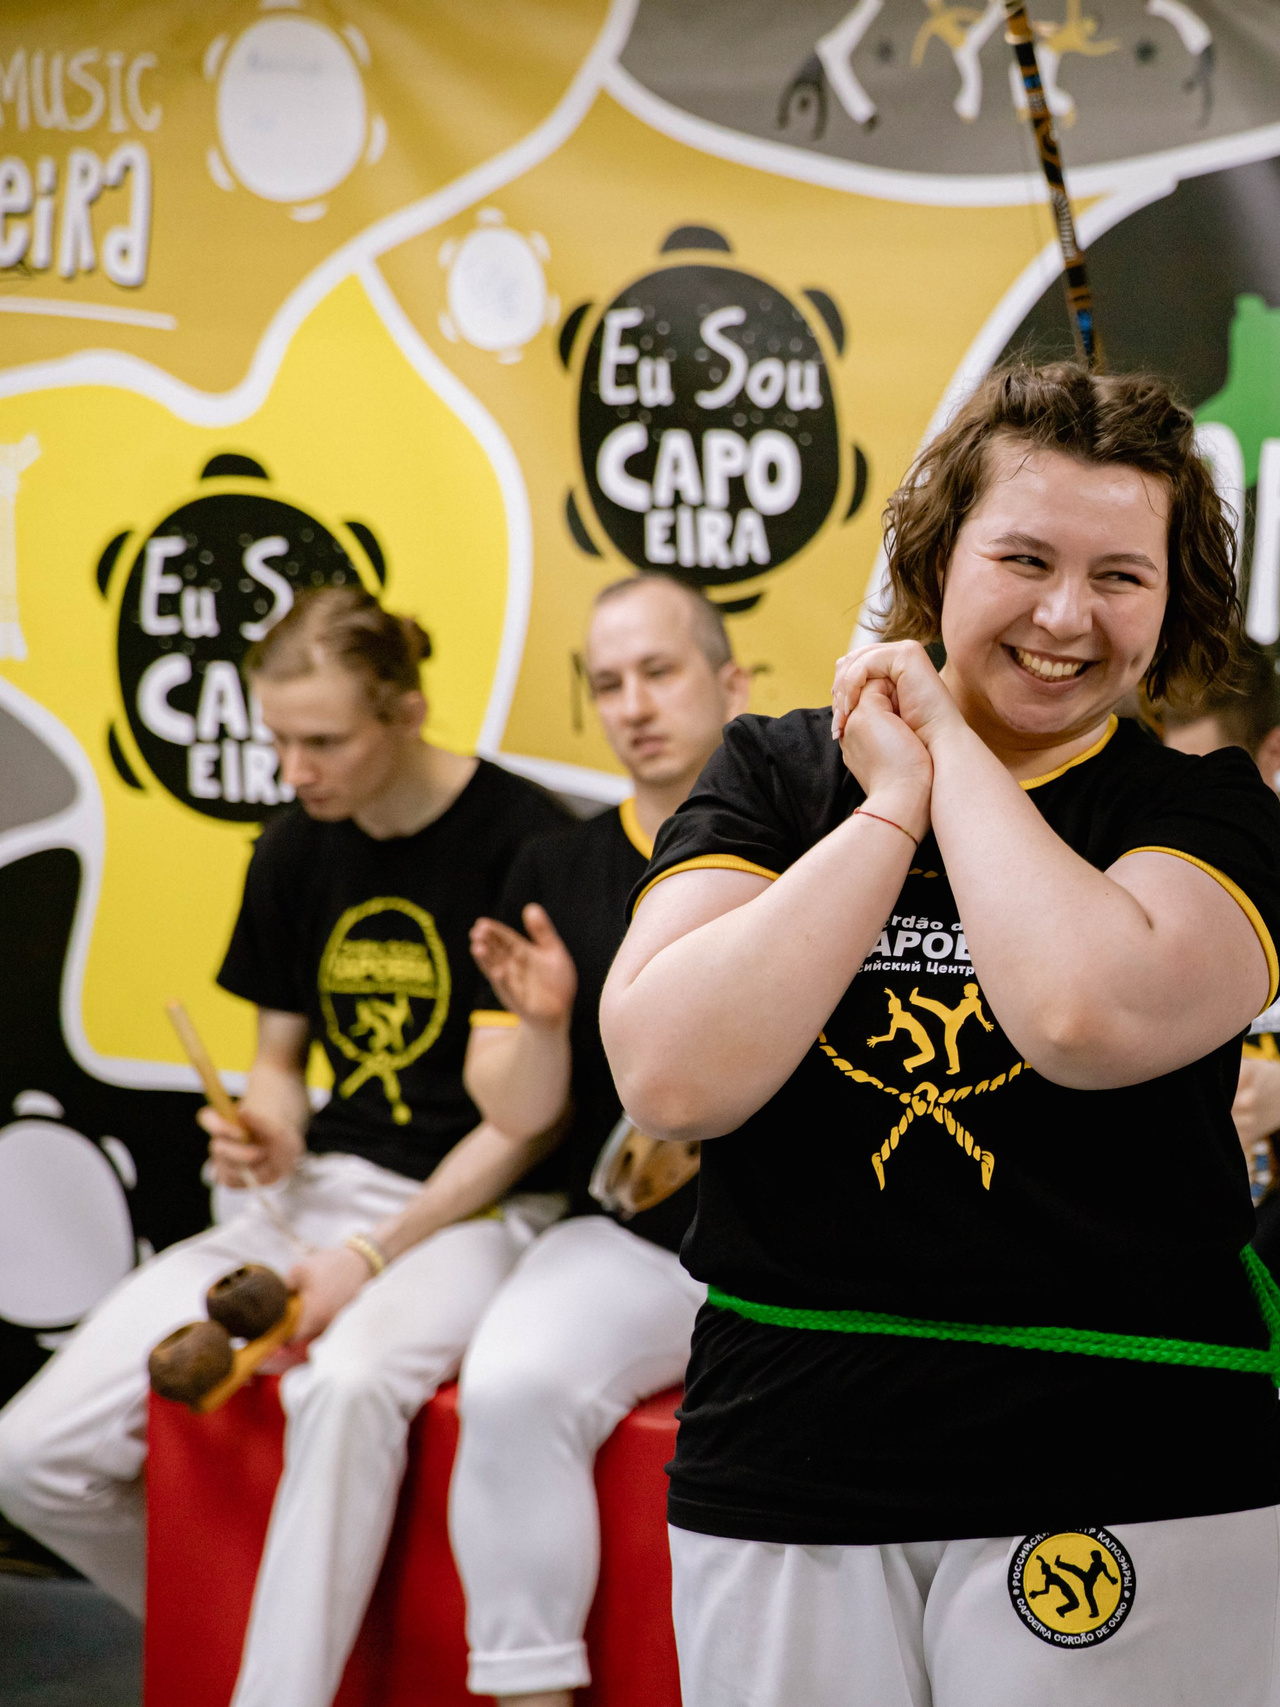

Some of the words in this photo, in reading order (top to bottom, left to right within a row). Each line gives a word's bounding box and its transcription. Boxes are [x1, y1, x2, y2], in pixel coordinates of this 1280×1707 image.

[598, 307, 676, 408] Eu
[694, 305, 824, 411] Sou
[596, 421, 802, 516] CAPO
[644, 503, 771, 570] EIRA
[139, 535, 222, 639] Eu
[187, 739, 297, 806] EIR
[888, 915, 944, 931] rdão
[1012, 1530, 1049, 1587] РОССИЙСК
[1097, 1531, 1133, 1587] КАПОЭЙРЫ
[1017, 1598, 1052, 1639] CAPOEIRA
[1095, 1625, 1110, 1638] DE
[1108, 1602, 1128, 1628] OURO
